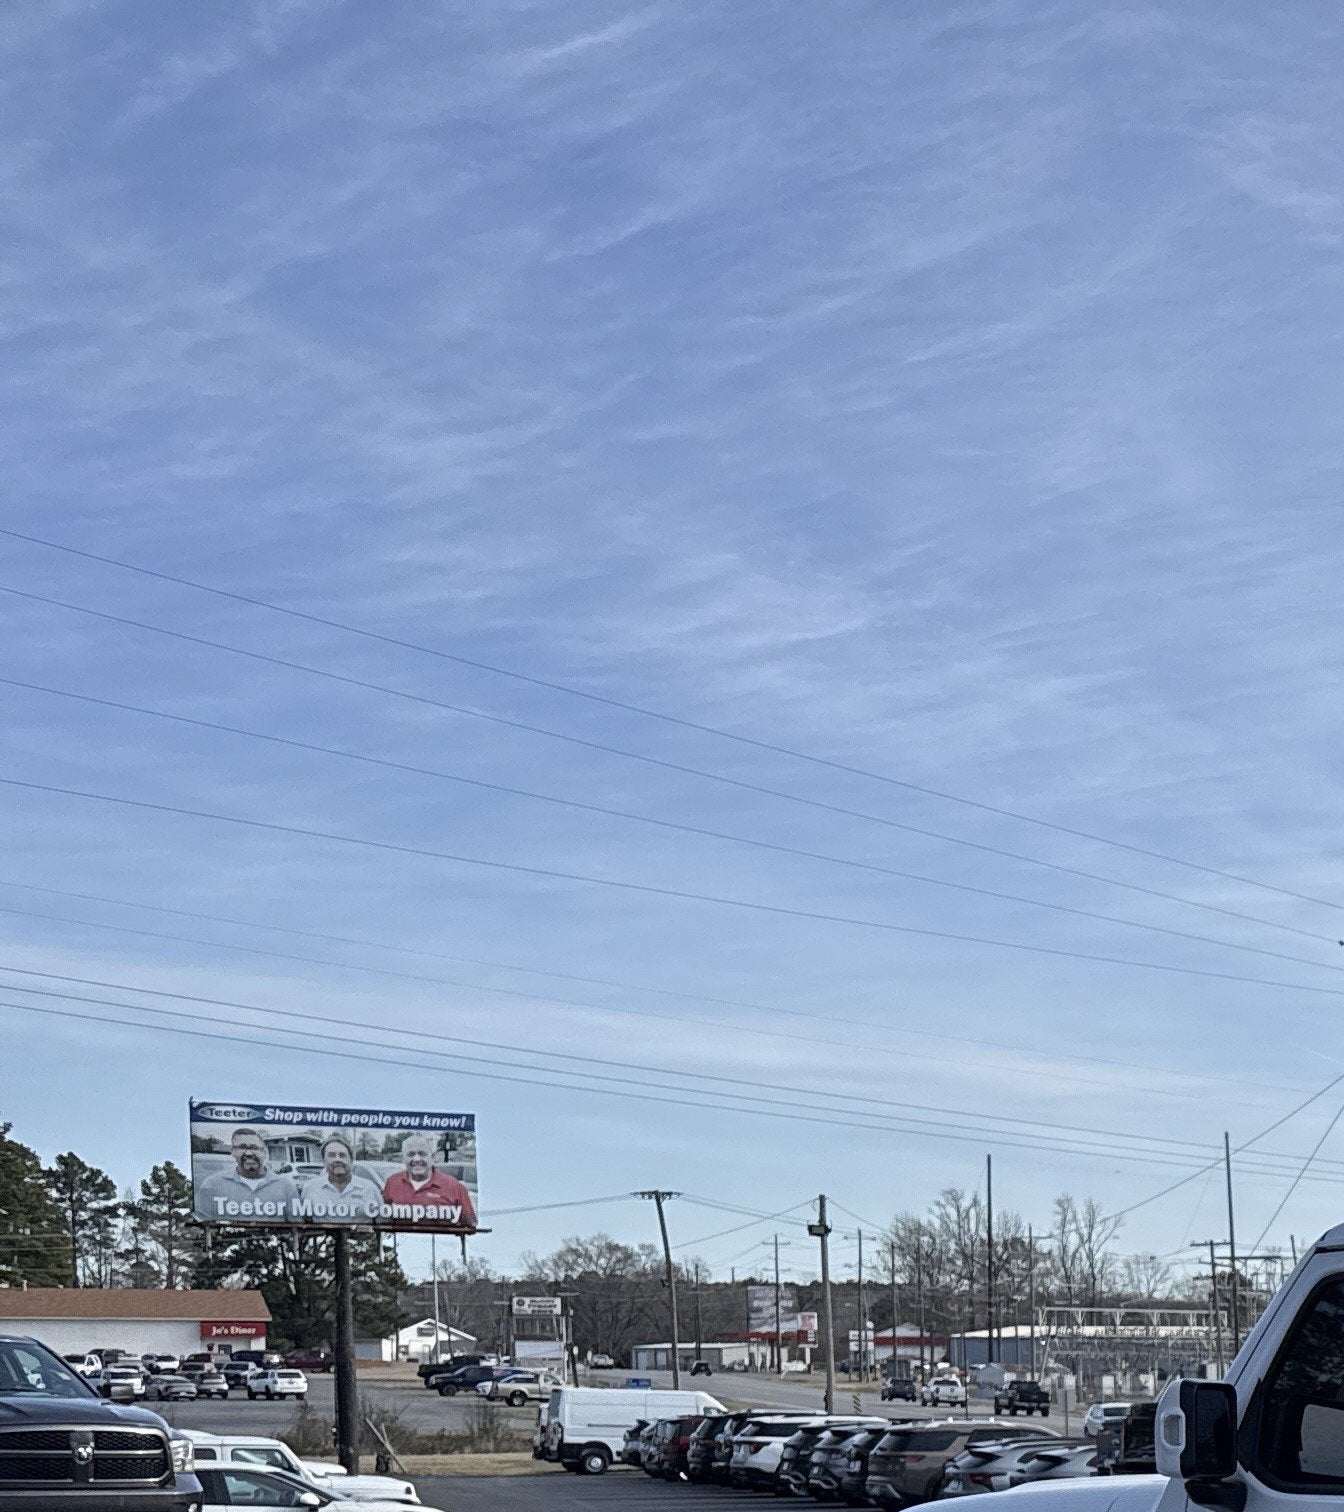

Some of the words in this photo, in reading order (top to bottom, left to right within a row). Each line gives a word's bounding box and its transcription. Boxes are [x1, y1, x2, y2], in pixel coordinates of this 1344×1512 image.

[206, 1107, 251, 1118] Teeter
[264, 1108, 303, 1123] Shop
[306, 1110, 338, 1123] with
[341, 1112, 392, 1126] people
[393, 1115, 420, 1128] you
[422, 1115, 466, 1128] know!
[214, 1197, 286, 1217] Teeter
[291, 1198, 358, 1218] Motor
[363, 1201, 462, 1224] Company
